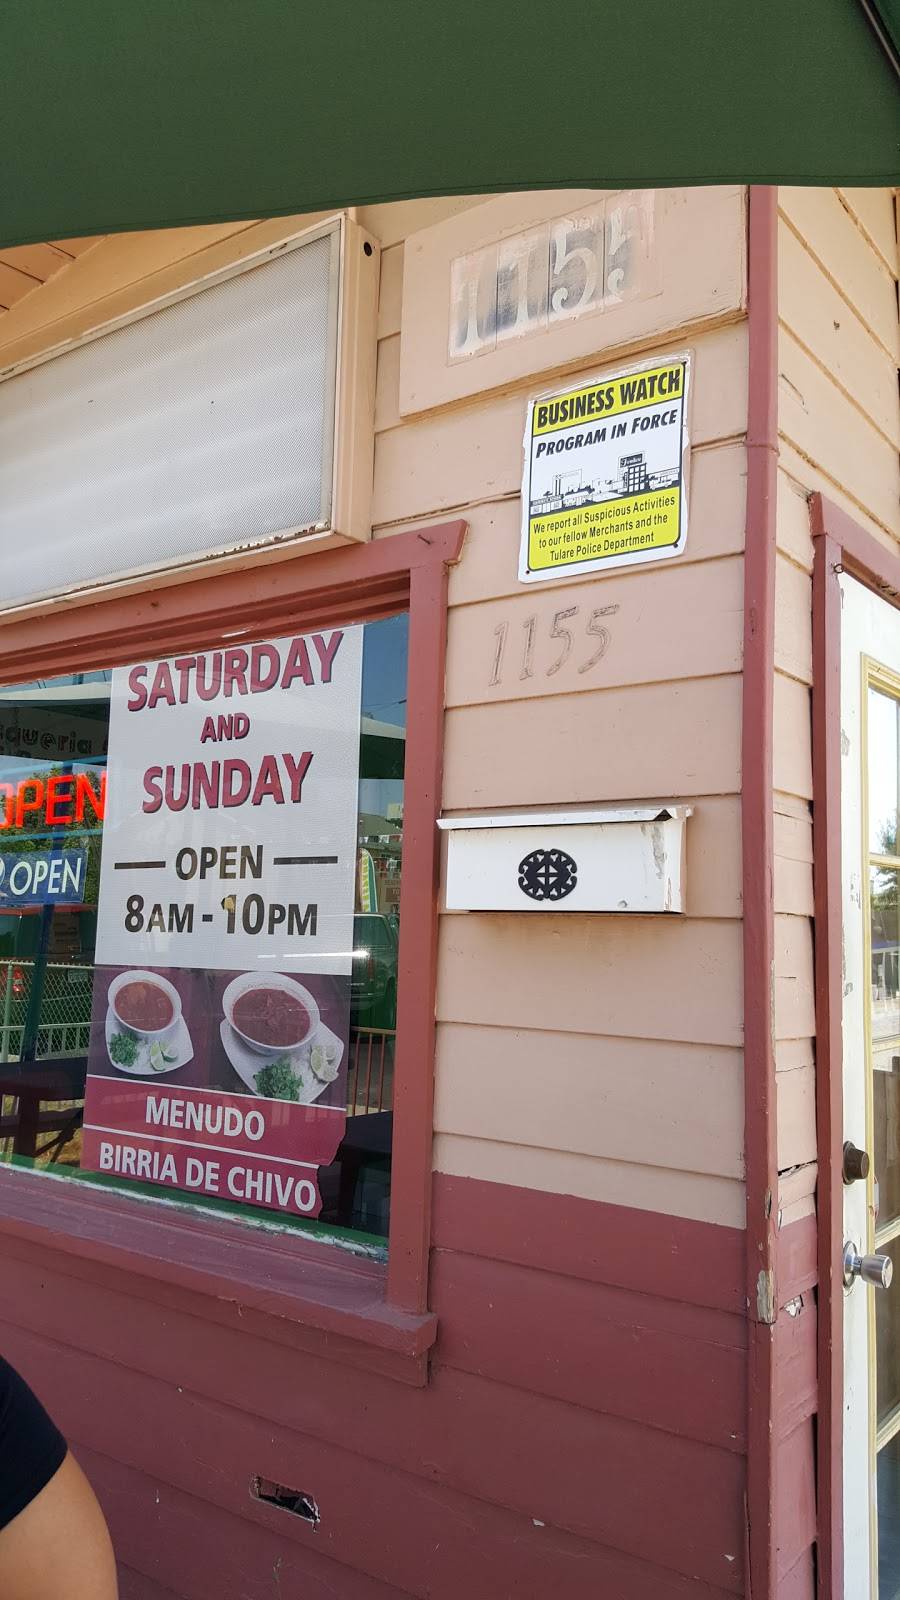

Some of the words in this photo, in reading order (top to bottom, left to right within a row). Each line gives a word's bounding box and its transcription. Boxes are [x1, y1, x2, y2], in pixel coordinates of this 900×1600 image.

[537, 387, 614, 428] BUSINESS
[620, 368, 681, 406] WATCH
[536, 428, 606, 458] PROGRAM
[611, 422, 627, 439] IN
[631, 409, 678, 434] FORCE
[533, 523, 546, 534] We
[546, 518, 571, 534] report
[572, 515, 583, 527] all
[584, 505, 631, 524] Suspicious
[633, 496, 675, 512] Activities
[538, 538, 547, 549] to
[548, 535, 562, 545] our
[563, 530, 588, 544] fellow
[589, 520, 634, 536] Merchants
[635, 516, 651, 529] and
[653, 513, 668, 525] the
[550, 548, 574, 561] Tulare
[576, 541, 602, 557] Police
[603, 532, 655, 553] Department
[489, 604, 620, 687] 1155
[127, 630, 344, 712] SATURDAY
[200, 712, 251, 743] AND
[142, 751, 314, 814] SUNDAY
[9, 857, 82, 896] OPEN
[175, 844, 264, 881] OPEN
[124, 894, 195, 933] 8AM
[220, 893, 318, 936] 10PM
[145, 1096, 265, 1141] MENUDO
[99, 1142, 178, 1184] BIRRIA
[185, 1157, 219, 1192] DE
[227, 1166, 316, 1212] CHIVO
